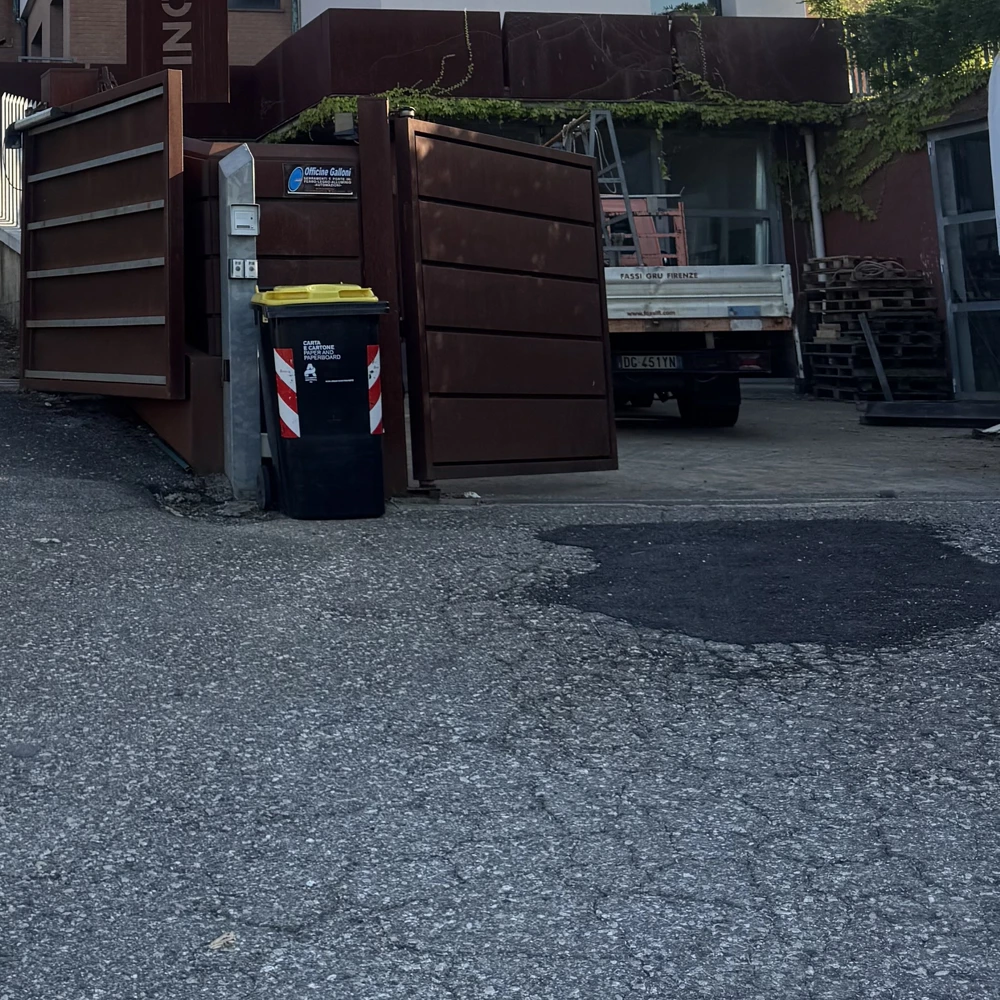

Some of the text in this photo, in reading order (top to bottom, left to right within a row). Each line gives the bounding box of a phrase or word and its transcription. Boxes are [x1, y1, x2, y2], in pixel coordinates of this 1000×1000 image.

[304, 166, 352, 177] Officine Galloni
[645, 272, 663, 280] GRU
